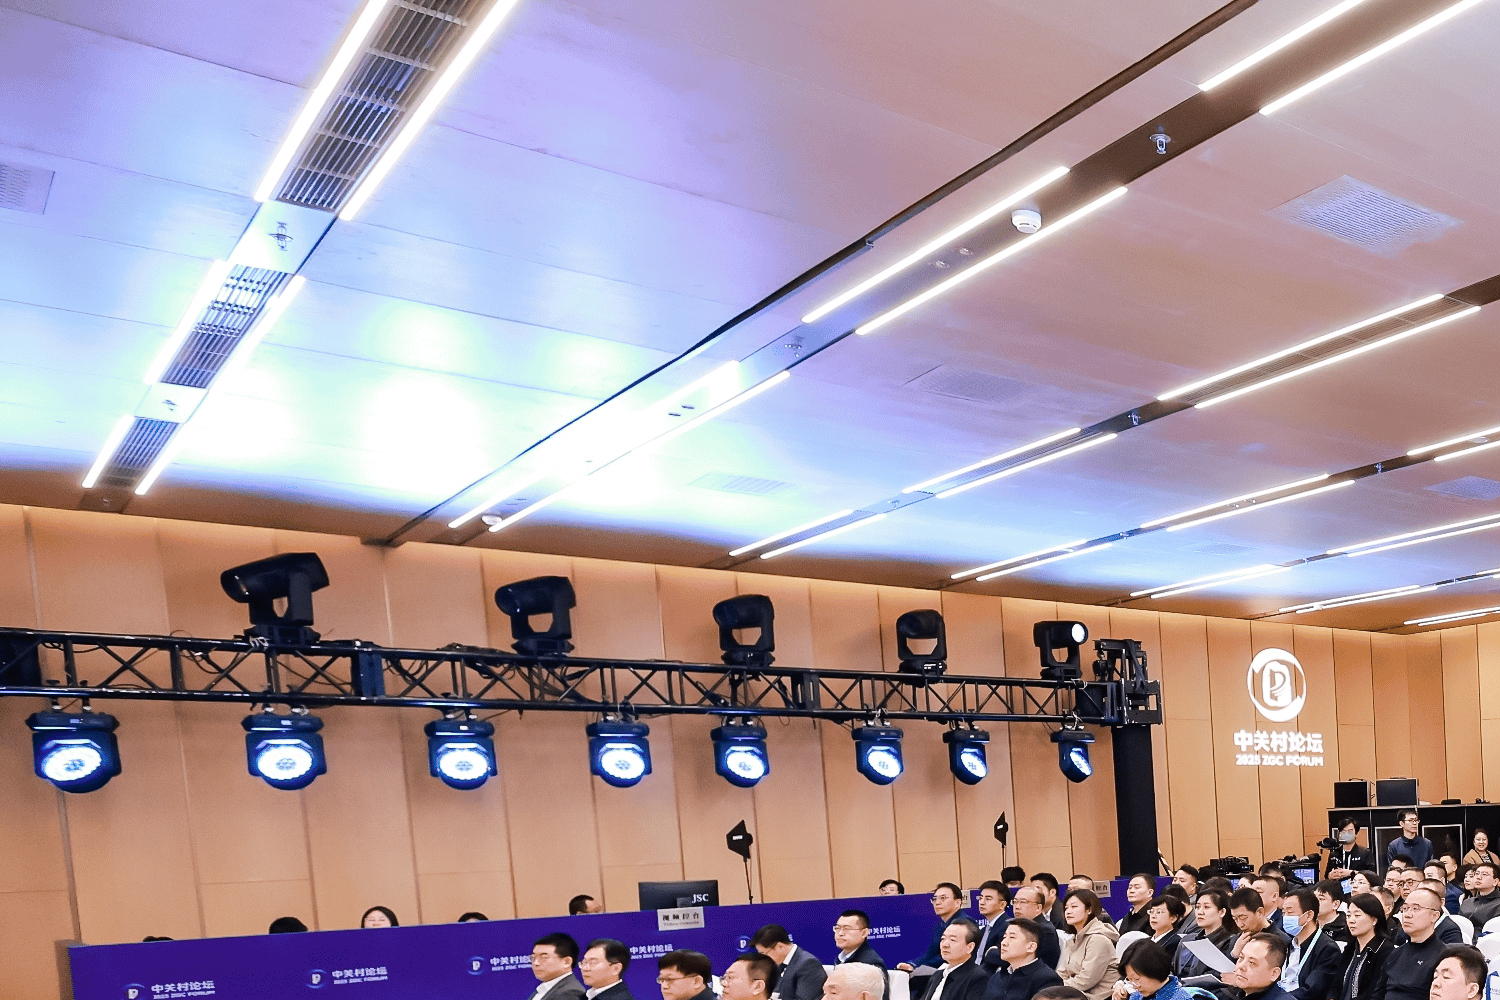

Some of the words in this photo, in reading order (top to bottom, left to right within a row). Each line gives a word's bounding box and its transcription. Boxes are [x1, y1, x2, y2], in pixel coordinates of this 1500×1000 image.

[1233, 729, 1324, 753] 中关村论坛
[1235, 754, 1261, 766] 2025
[1261, 755, 1284, 767] ZGC
[1285, 755, 1324, 767] FORUM
[692, 893, 709, 904] JSC
[629, 943, 674, 955] 中关村论坛
[331, 966, 388, 979] 中关村论坛
[150, 980, 216, 994] 中关村论坛
